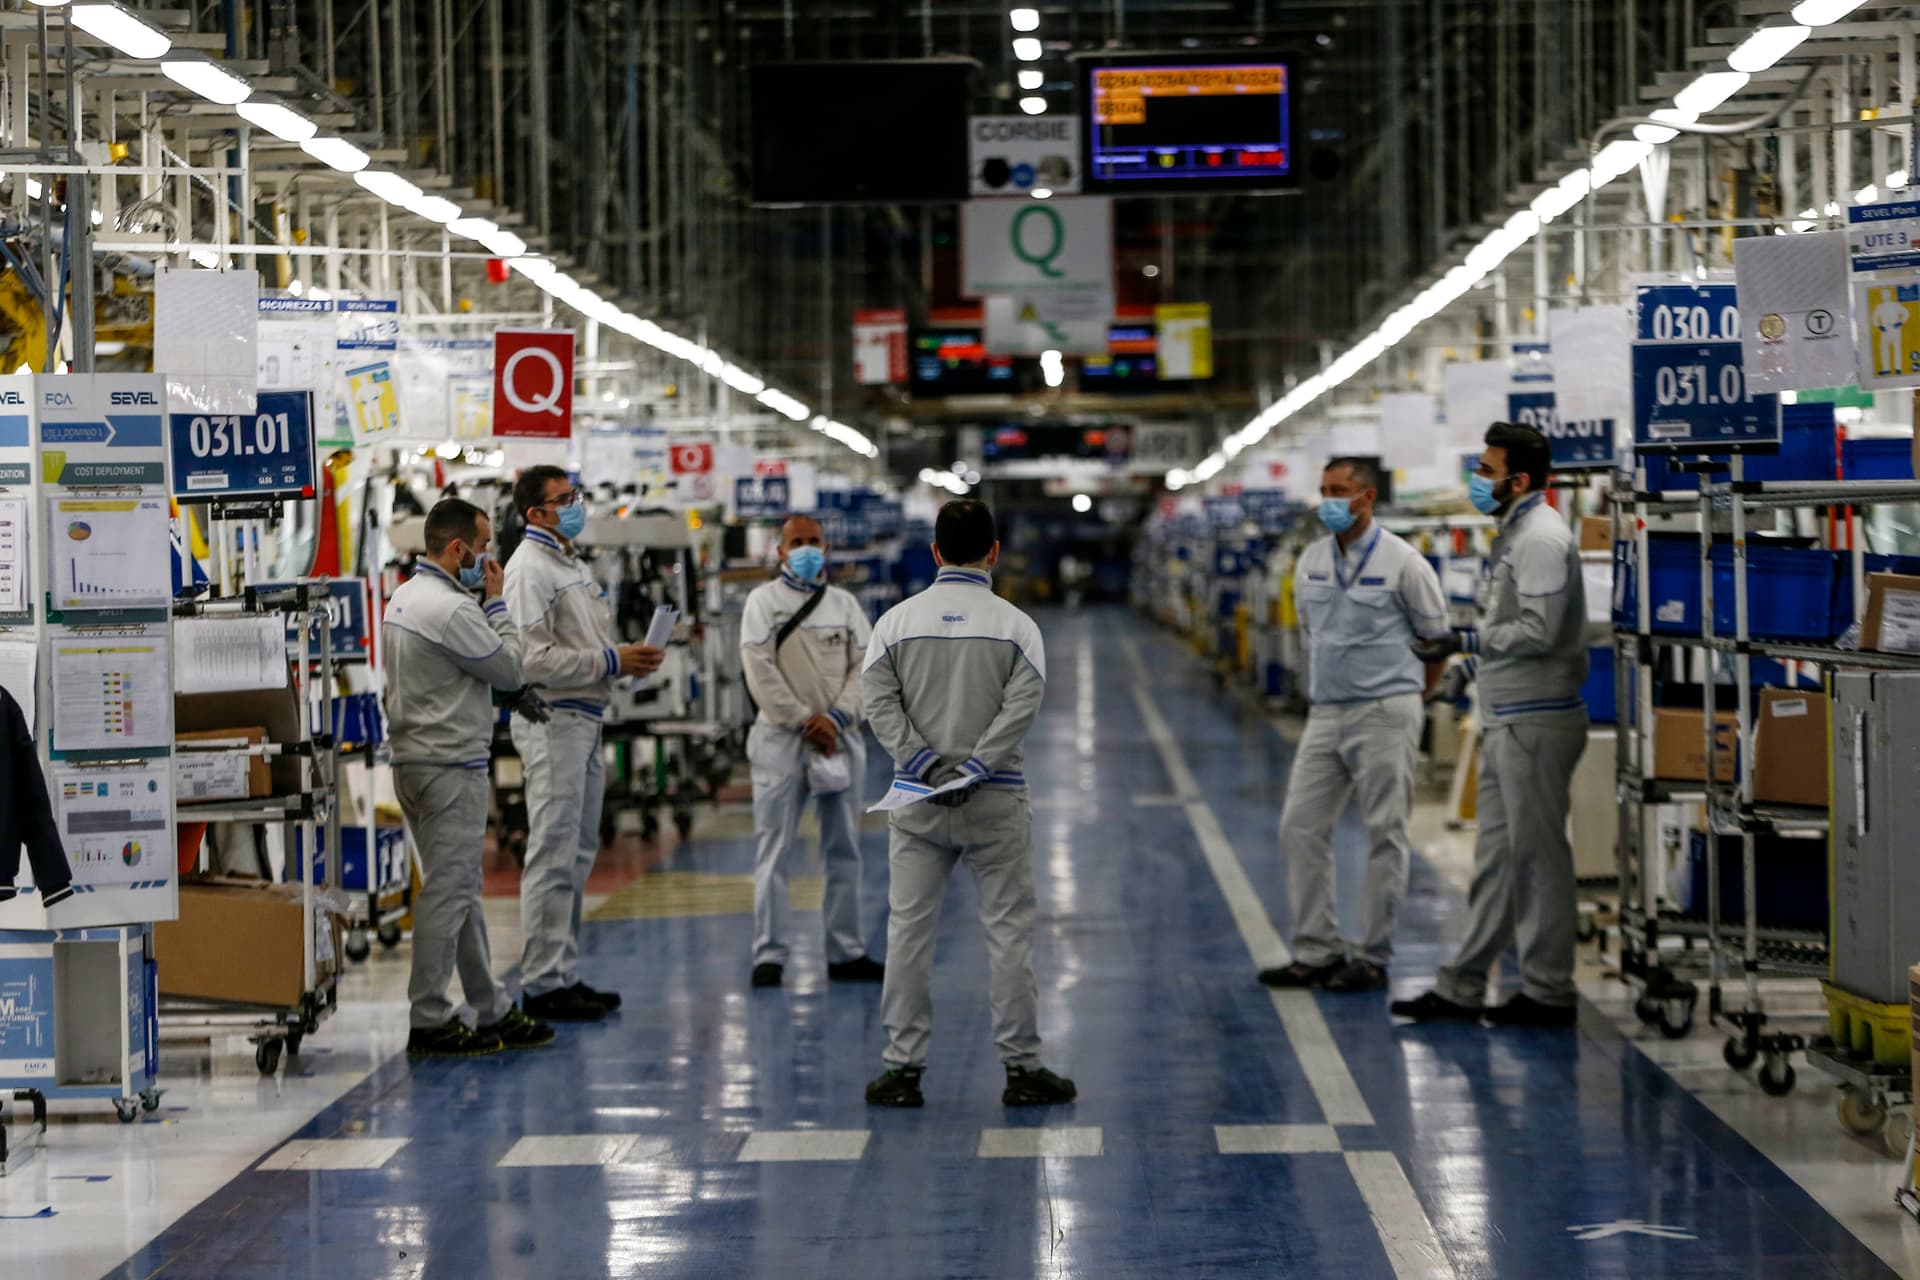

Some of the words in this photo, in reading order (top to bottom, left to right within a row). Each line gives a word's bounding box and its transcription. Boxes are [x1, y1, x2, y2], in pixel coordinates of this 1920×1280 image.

[976, 121, 1072, 142] CORSIE
[1861, 209, 1890, 218] SEVEL
[1010, 204, 1065, 278] Q
[1864, 233, 1894, 248] UTE
[1898, 232, 1908, 245] 3
[260, 300, 322, 310] SICUREZZA
[388, 320, 400, 334] 3
[1652, 304, 1742, 340] 030.0
[502, 346, 565, 418] Q
[45, 393, 73, 405] FCA
[111, 392, 158, 404] SEVEL
[190, 413, 290, 457] 031.01
[0, 468, 25, 479] ZATION
[74, 467, 94, 477] COST
[96, 466, 145, 477] DEPLOYMENT
